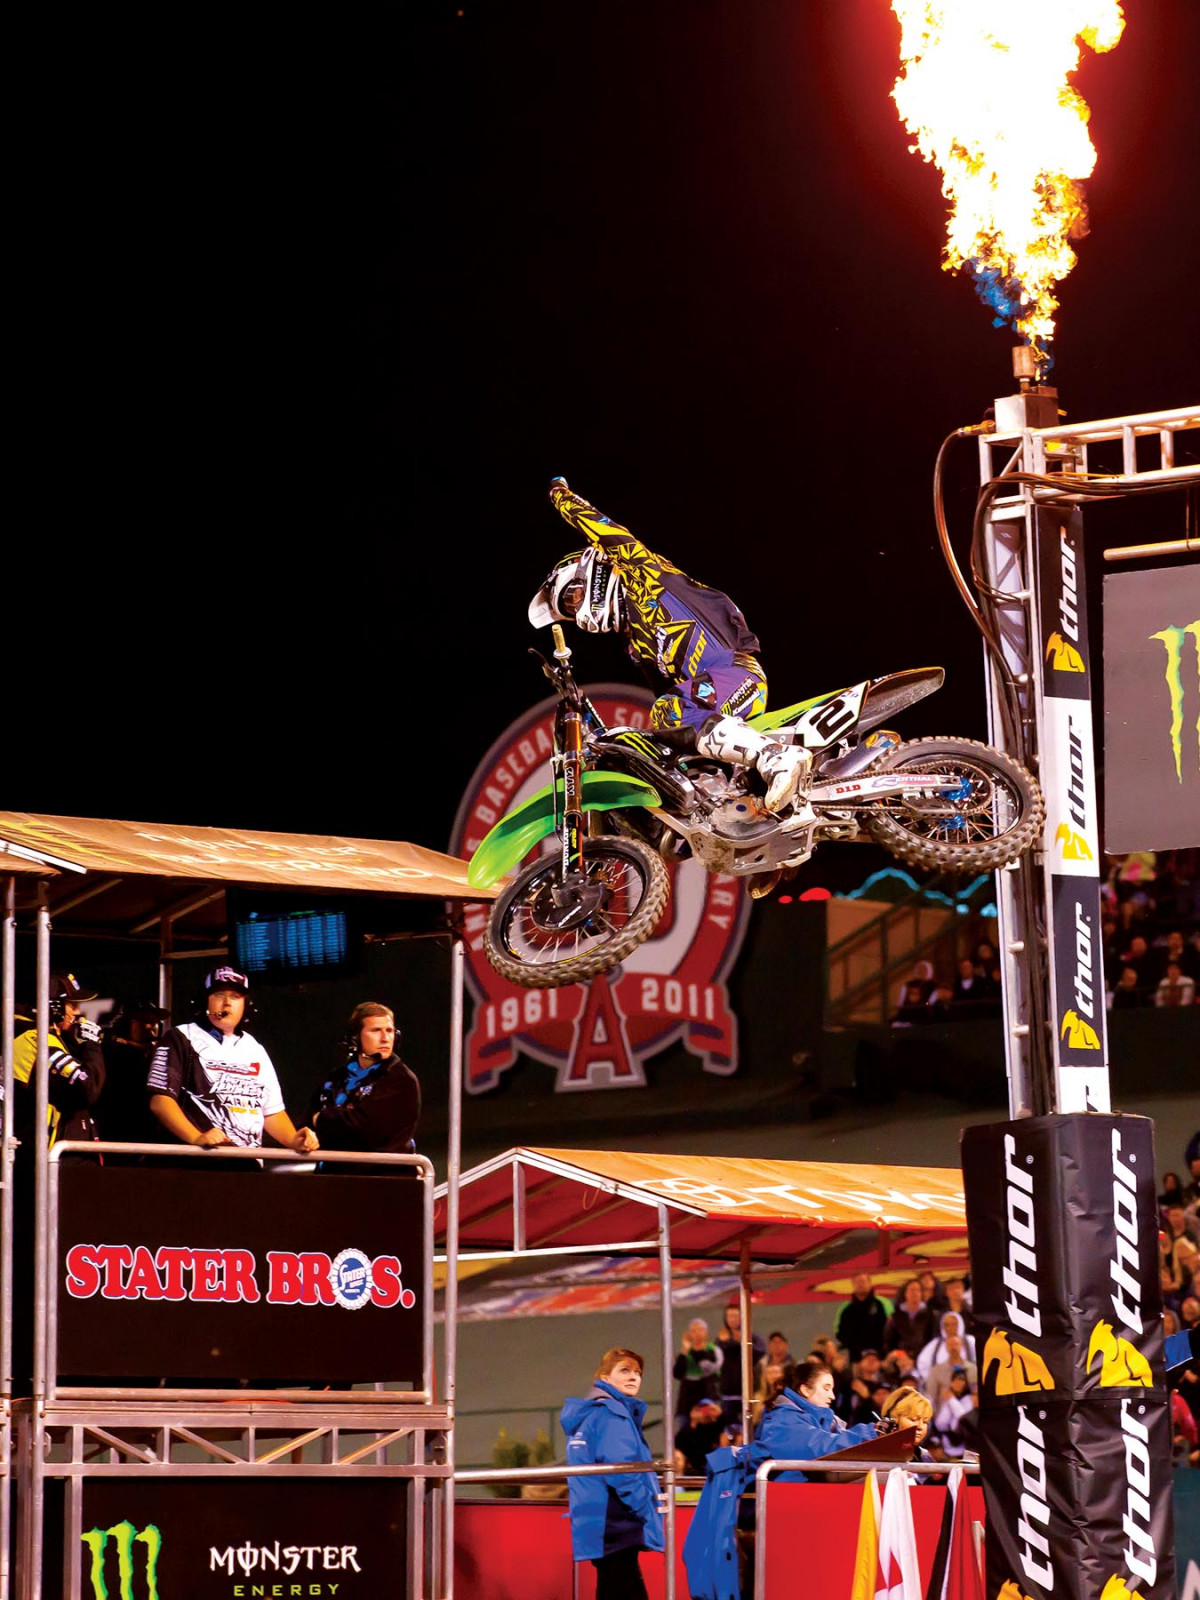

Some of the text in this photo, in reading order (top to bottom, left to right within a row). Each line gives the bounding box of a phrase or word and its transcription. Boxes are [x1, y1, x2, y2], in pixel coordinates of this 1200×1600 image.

[1058, 525, 1079, 642] thor
[688, 629, 707, 677] thor
[808, 699, 855, 742] 2
[475, 725, 552, 825] BASEBA
[1067, 714, 1086, 829] thor
[640, 978, 715, 1021] 2011
[1073, 901, 1095, 1019] thor
[485, 996, 558, 1038] 1961
[66, 1243, 260, 1303] STATER
[1002, 1133, 1042, 1338] thor
[1110, 1127, 1144, 1335] thor
[1017, 1405, 1055, 1592] thor
[1121, 1397, 1158, 1588] thor
[209, 1540, 362, 1577] MONSTER
[233, 1583, 340, 1597] ENERGY
